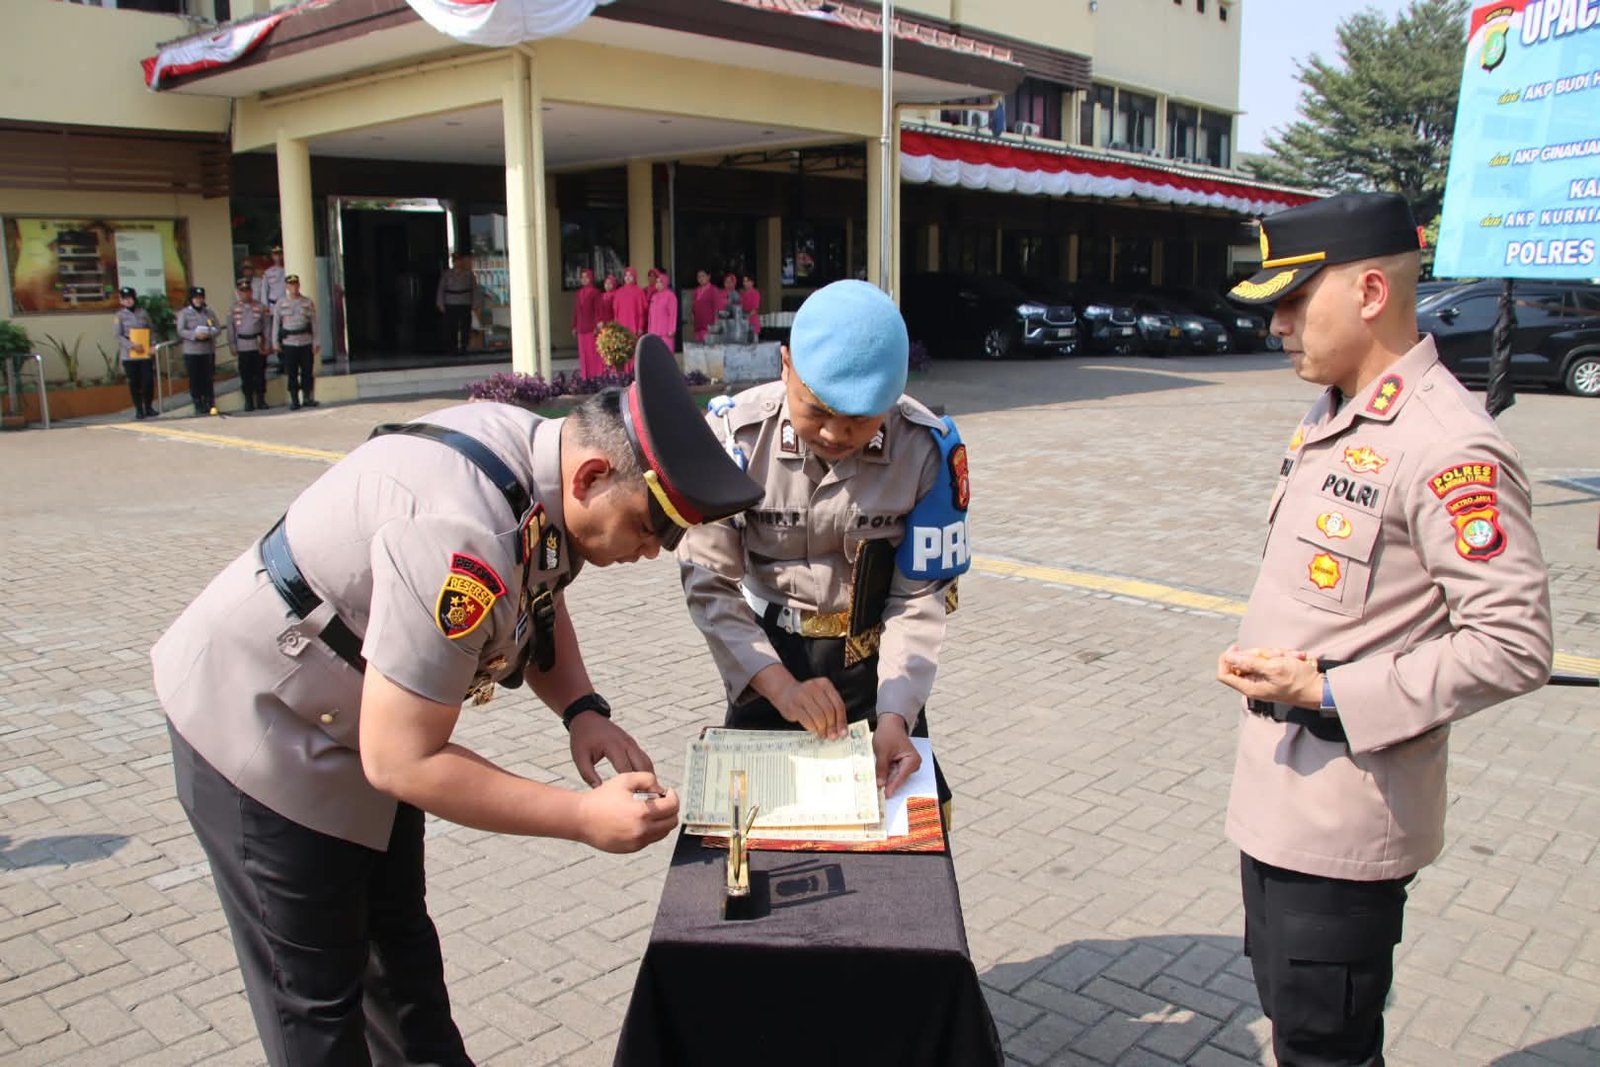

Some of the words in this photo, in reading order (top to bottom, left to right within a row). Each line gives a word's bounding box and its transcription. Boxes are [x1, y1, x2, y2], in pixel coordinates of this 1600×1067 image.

[1521, 0, 1600, 46] UPAC
[1523, 82, 1553, 101] AKP
[1555, 74, 1590, 94] BUDI
[1513, 148, 1540, 165] AKP
[1570, 178, 1600, 199] KA
[1504, 211, 1536, 227] AKP
[1505, 239, 1595, 265] POLRES
[1433, 465, 1492, 489] POLRES
[1322, 474, 1380, 508] POLRI
[912, 520, 971, 571] PR
[450, 578, 492, 605] RESERSE
